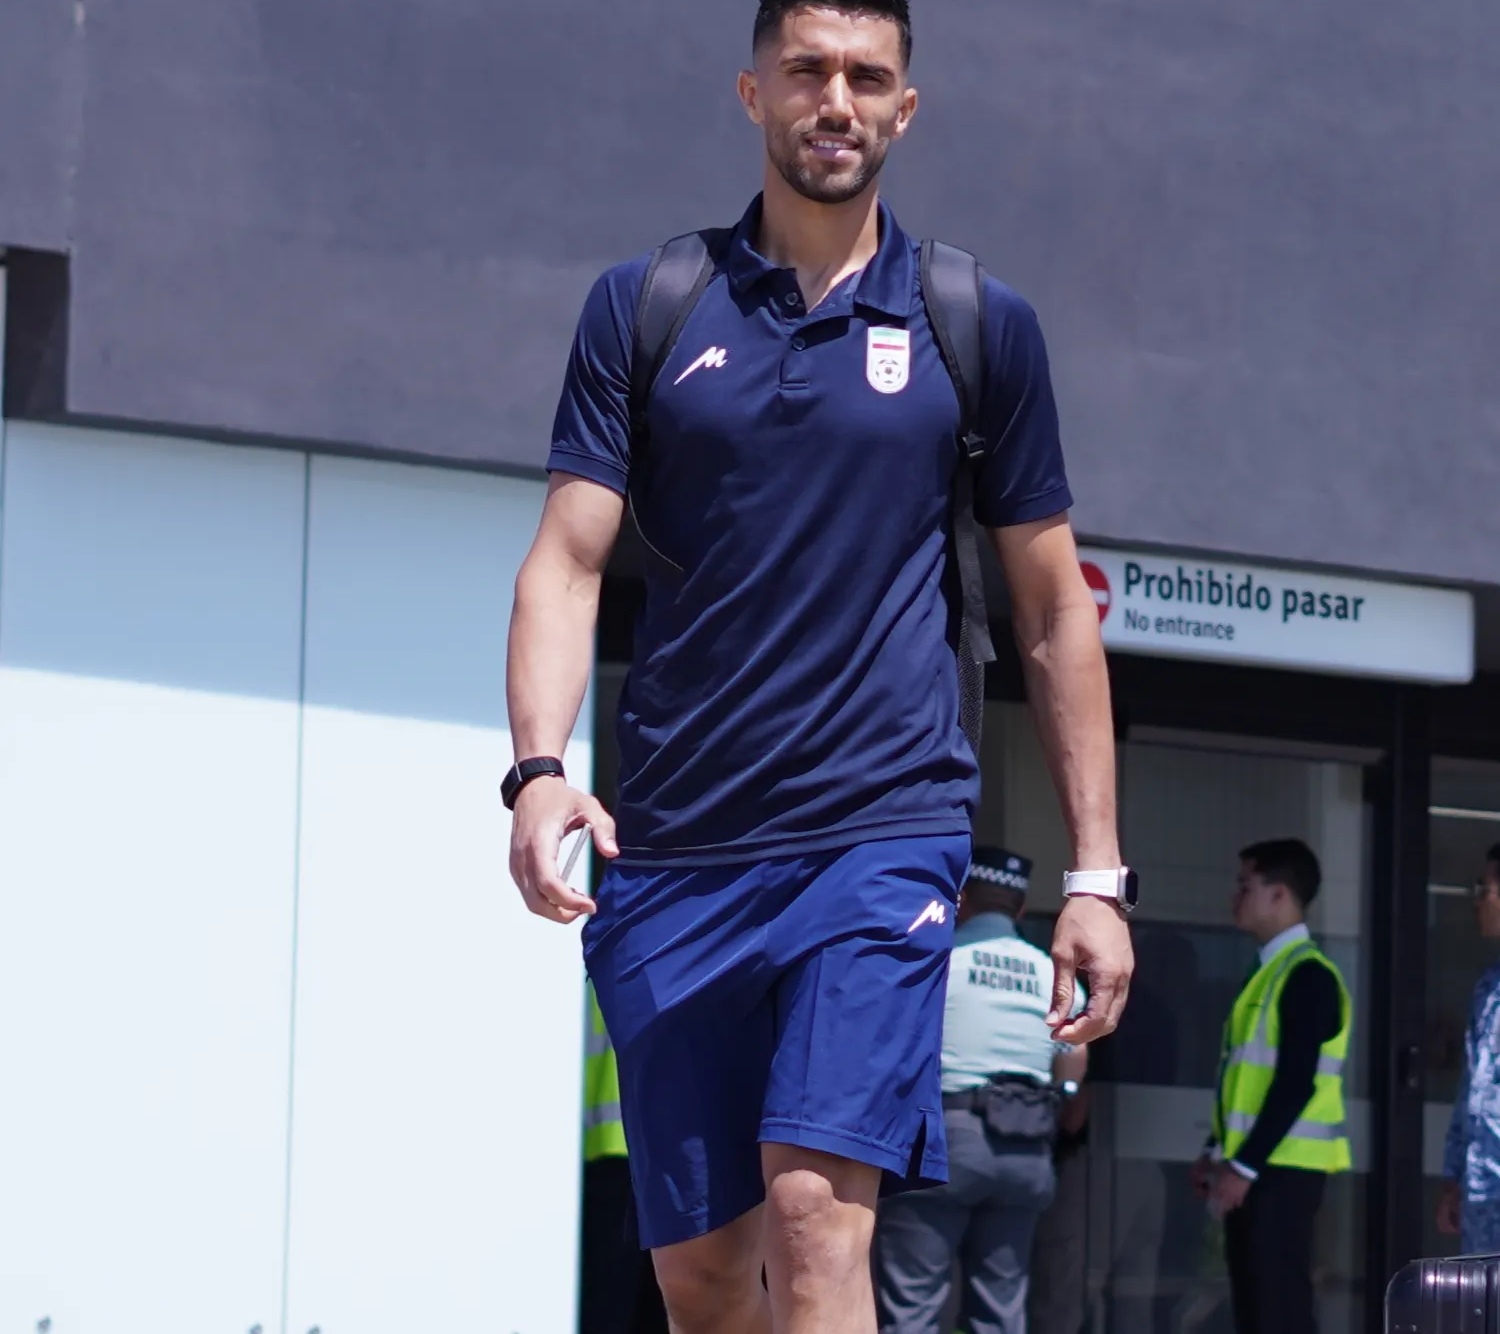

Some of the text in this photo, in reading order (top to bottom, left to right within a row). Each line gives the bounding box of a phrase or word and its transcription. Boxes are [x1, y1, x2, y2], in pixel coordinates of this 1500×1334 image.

[1124, 562, 1364, 623] Prohibido pasar
[1125, 609, 1235, 641] No entrance
[972, 950, 1036, 975] GUARDIA
[968, 968, 1040, 997] NACIONAL
